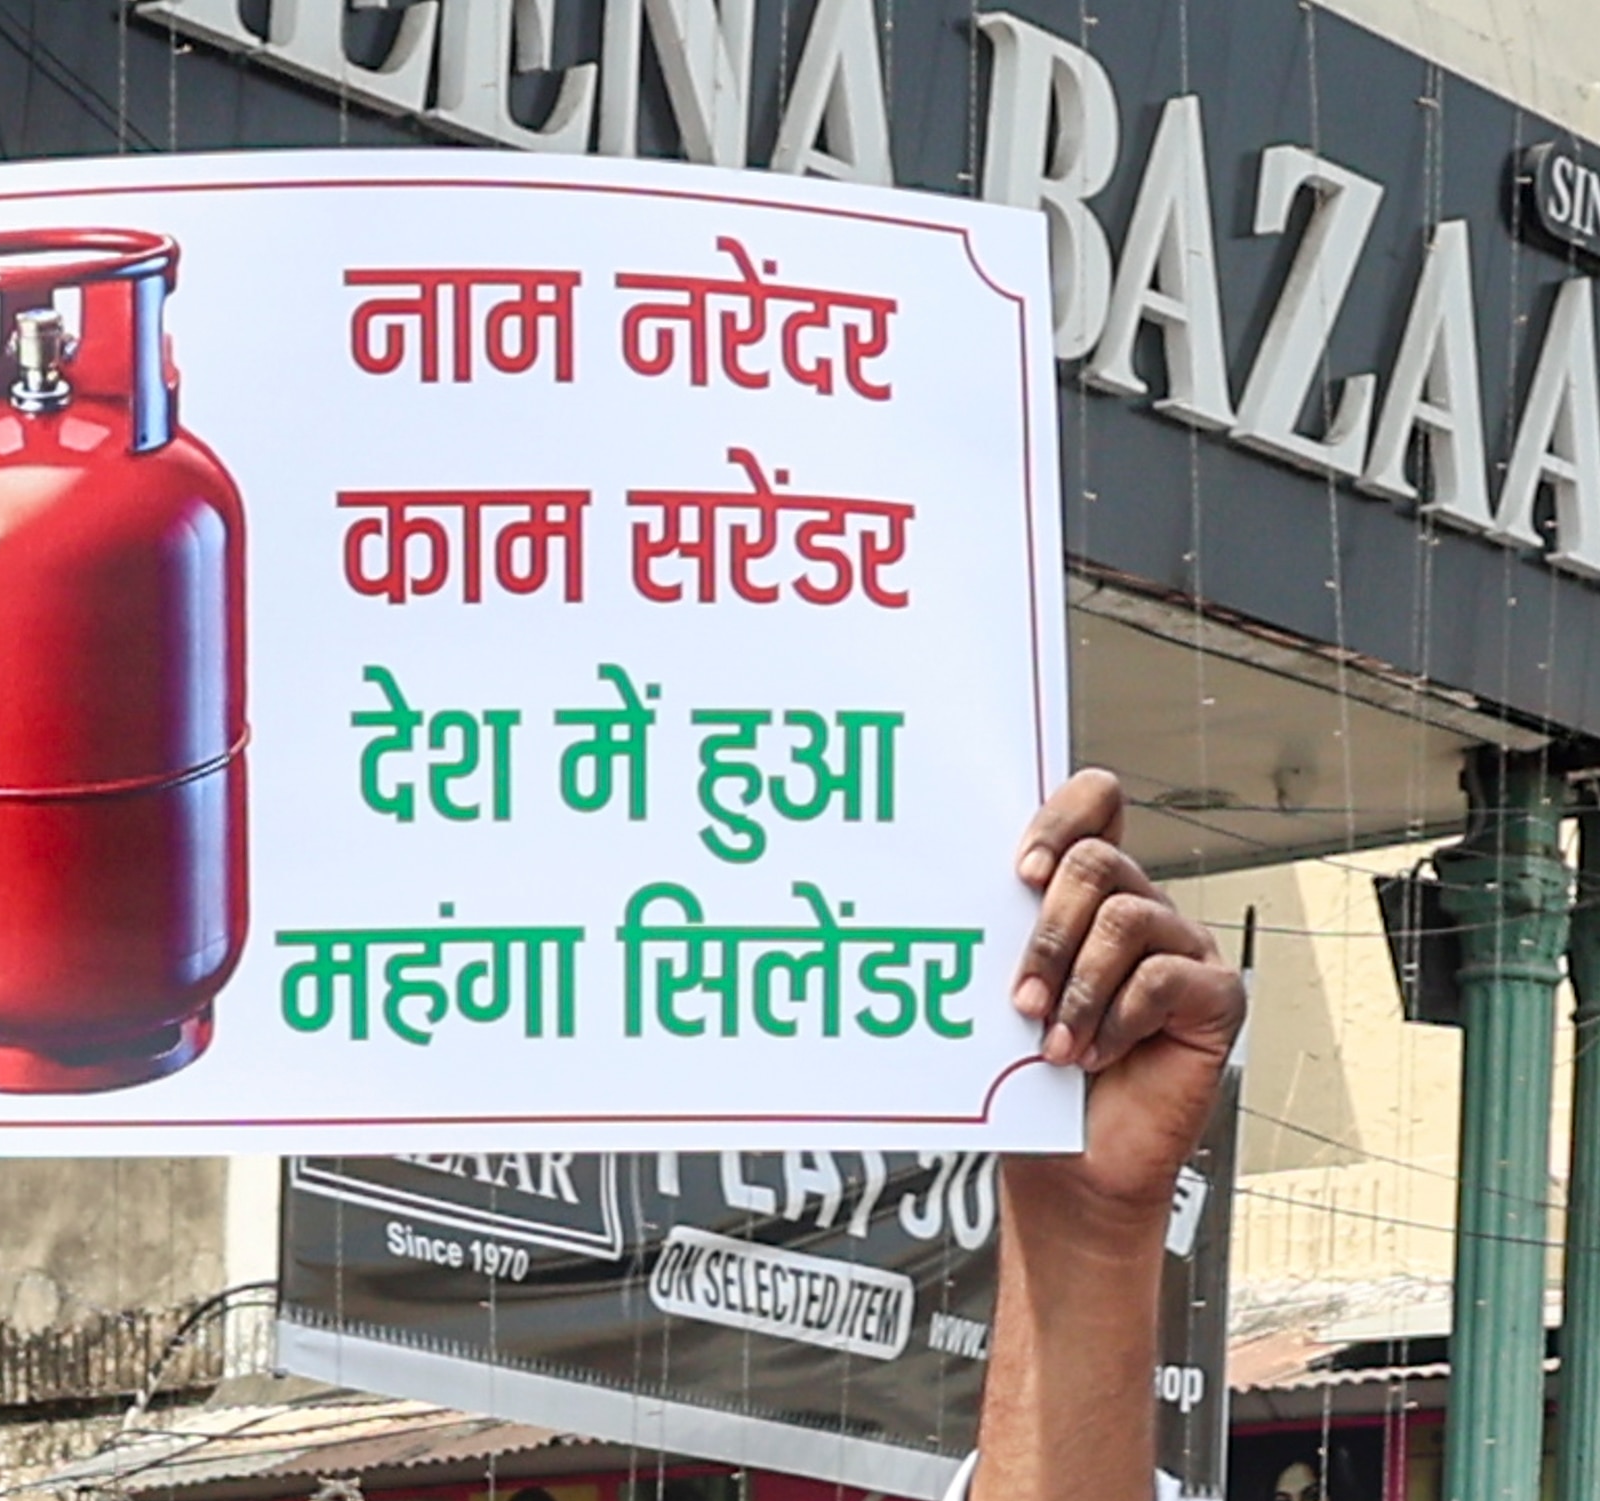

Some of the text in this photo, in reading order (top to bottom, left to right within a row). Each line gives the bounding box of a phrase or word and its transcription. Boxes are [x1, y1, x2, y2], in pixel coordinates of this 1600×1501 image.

[345, 236, 898, 402] नाम नरेंदर
[336, 447, 915, 609] काम सरेंडर
[350, 662, 906, 864] देश में हुआ
[274, 880, 986, 1047] महंगा सिलेंडर
[385, 1220, 530, 1283] Since 1970
[655, 1242, 903, 1347] ON SELECTED ITEM
